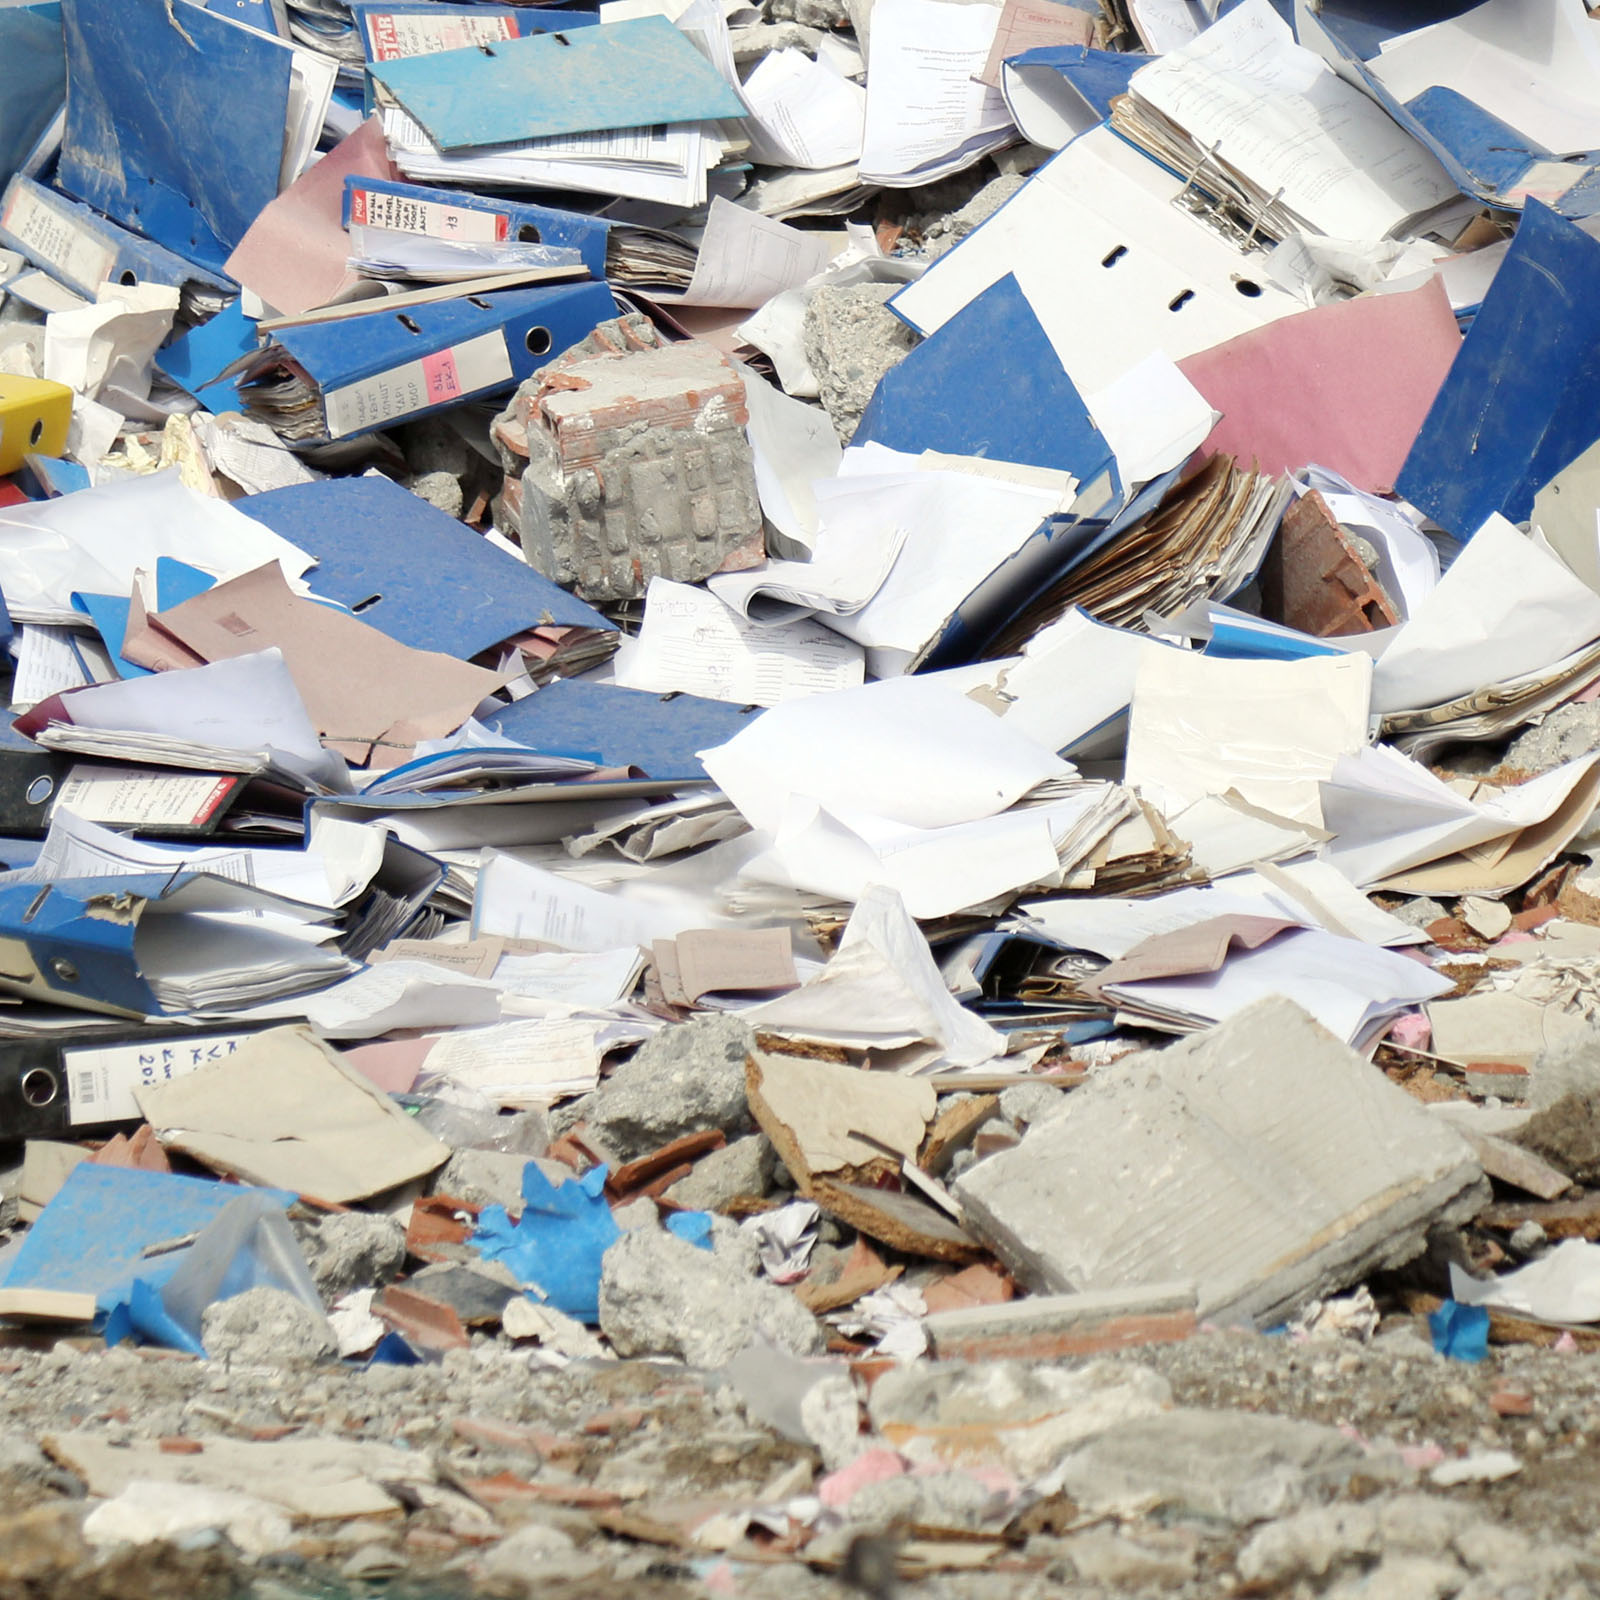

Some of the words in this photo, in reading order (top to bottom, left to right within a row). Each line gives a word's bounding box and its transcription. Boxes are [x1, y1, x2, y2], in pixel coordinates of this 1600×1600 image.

[379, 14, 399, 60] STAR
[385, 195, 394, 228] TEMEL
[395, 197, 403, 228] KONUT
[403, 203, 411, 230] YAPI
[446, 215, 458, 231] 13
[379, 381, 390, 417] KONUT
[394, 386, 406, 415] YAPI
[407, 382, 418, 409] KOOP
